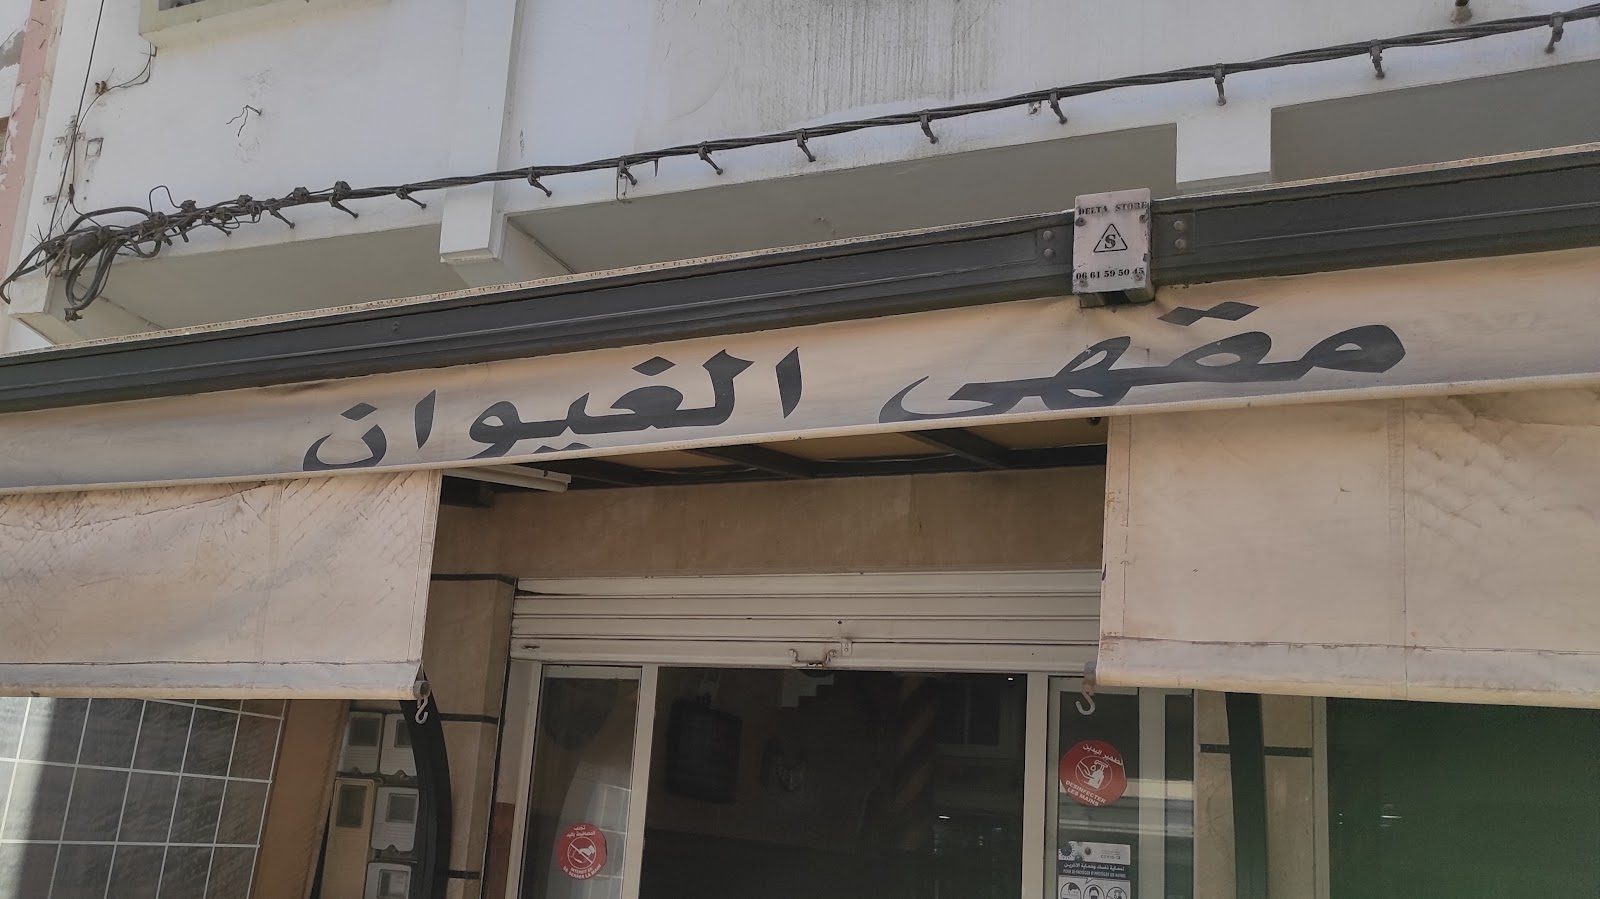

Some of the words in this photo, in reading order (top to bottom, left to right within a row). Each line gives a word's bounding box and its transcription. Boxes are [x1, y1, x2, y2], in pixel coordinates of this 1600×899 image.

[1078, 205, 1108, 216] DELTA
[1104, 234, 1116, 249] S
[1076, 271, 1088, 280] 06
[1090, 270, 1101, 279] 61
[1104, 269, 1116, 278] 59
[1118, 268, 1130, 277] 50
[878, 301, 1406, 423] مقهى
[302, 347, 802, 472] الغيوان
[1079, 794, 1100, 807] MAINS
